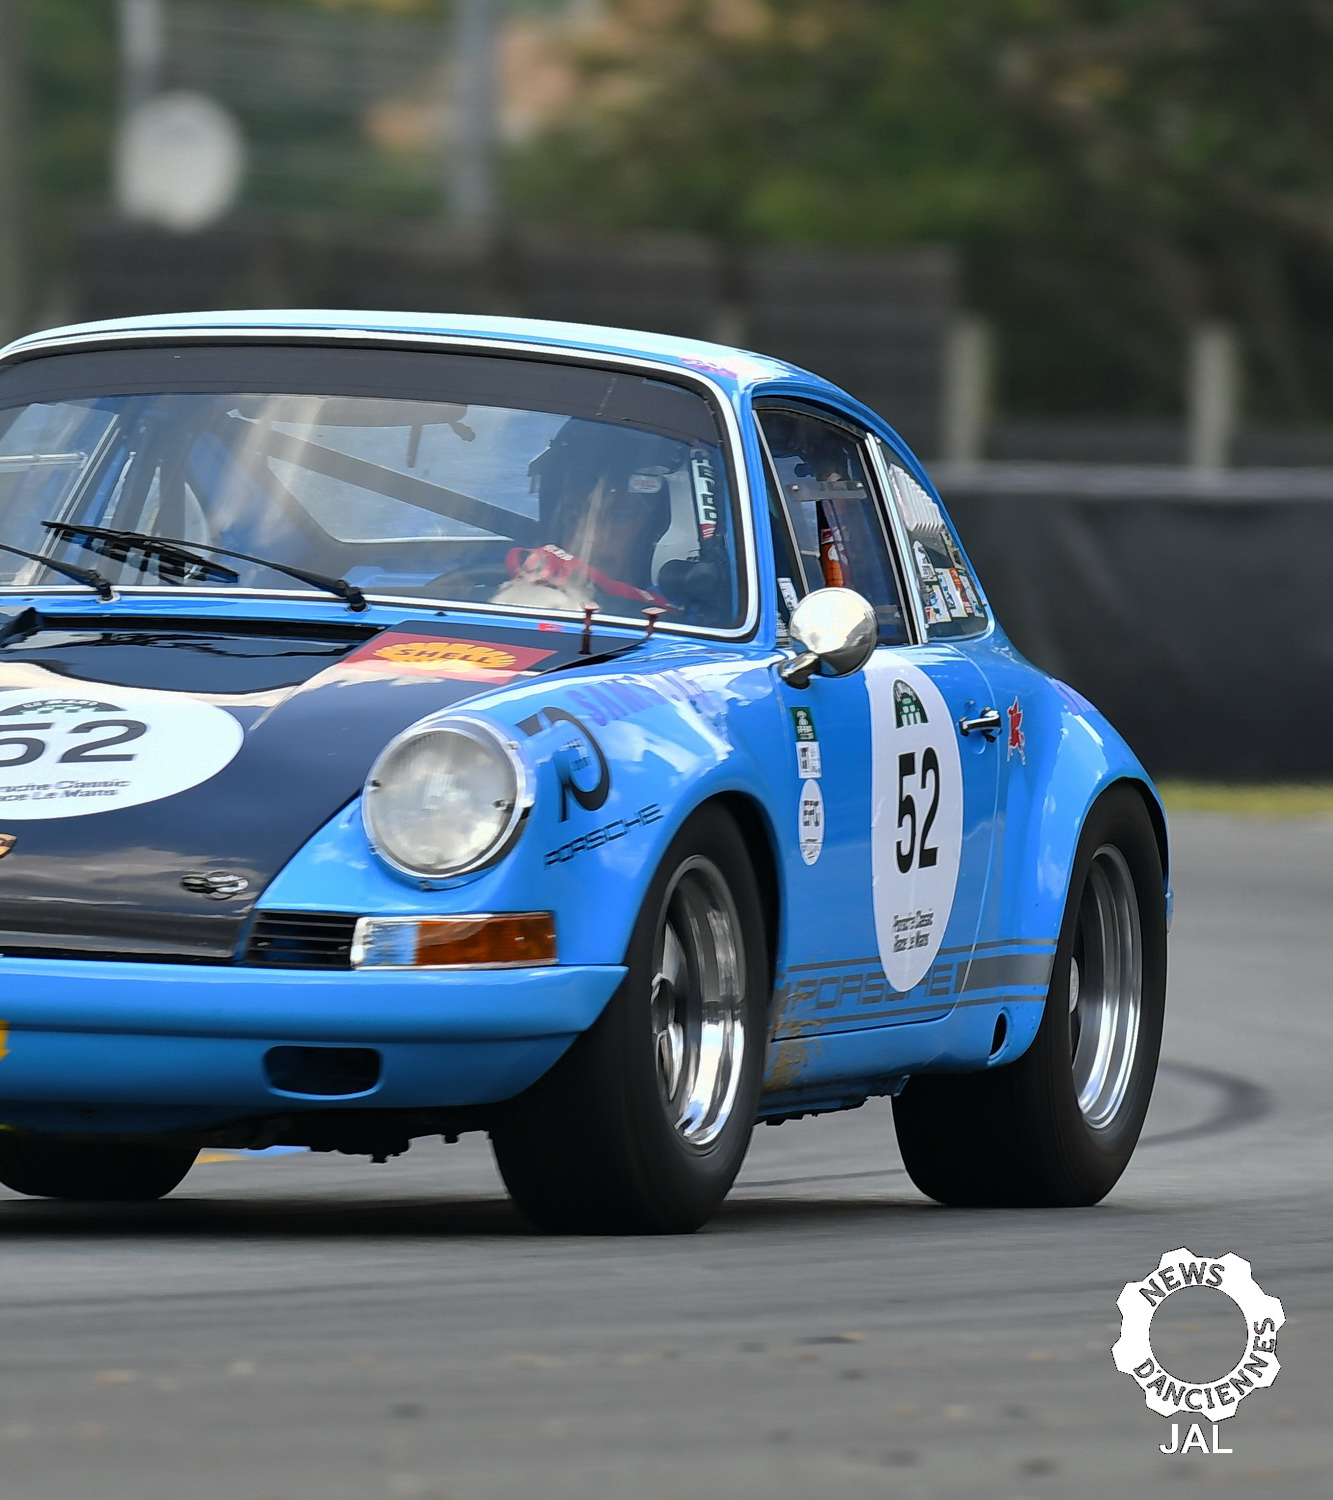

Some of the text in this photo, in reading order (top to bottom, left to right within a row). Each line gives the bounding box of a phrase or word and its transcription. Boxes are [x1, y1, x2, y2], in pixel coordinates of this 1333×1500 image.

[394, 648, 493, 664] SHELL
[543, 803, 665, 869] PORSCHE
[895, 747, 941, 874] 52
